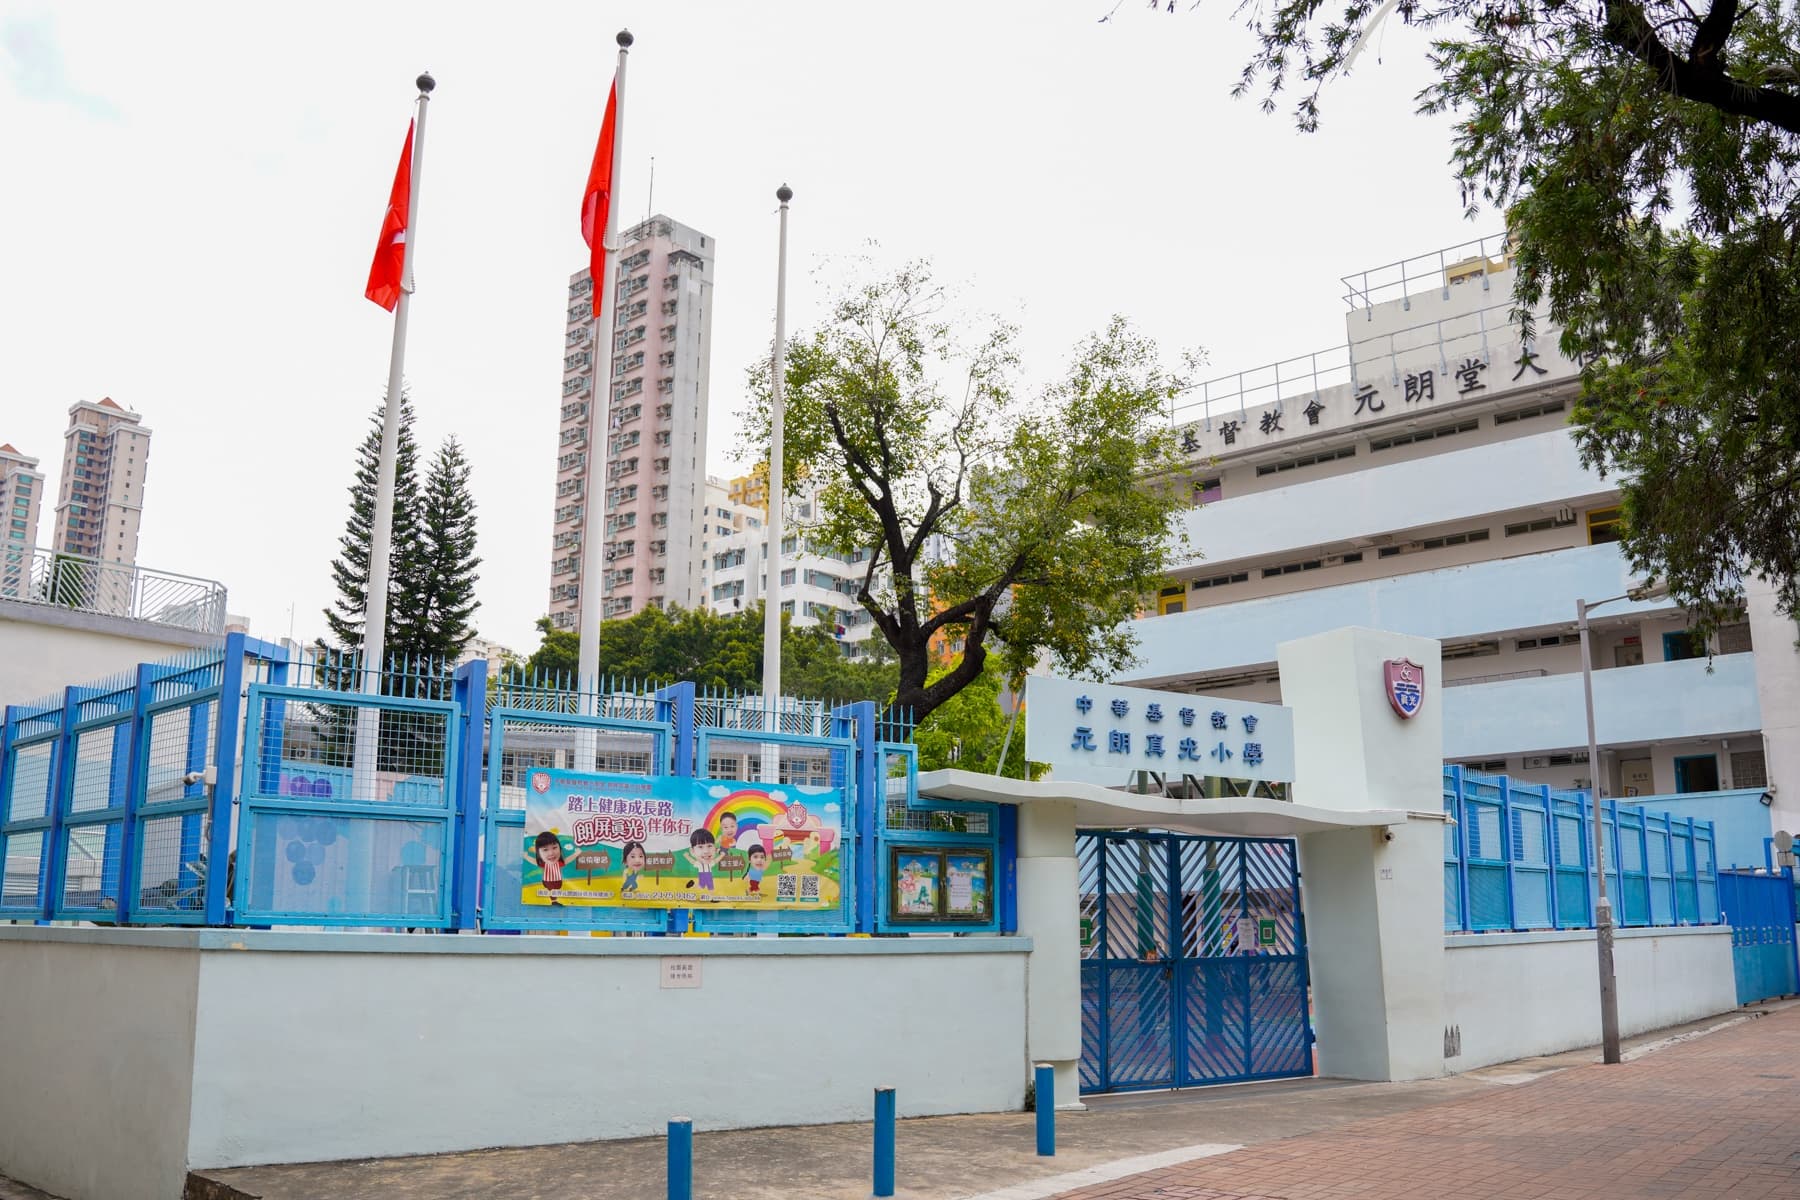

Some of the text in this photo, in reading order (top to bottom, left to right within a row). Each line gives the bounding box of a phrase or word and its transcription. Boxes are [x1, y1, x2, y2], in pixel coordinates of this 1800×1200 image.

[1180, 344, 1600, 453] 基督教會元朗堂大
[1075, 694, 1259, 734] 中華基督教會
[1071, 726, 1265, 767] 元朗真光小學
[567, 795, 673, 817] 踏上健康成長路
